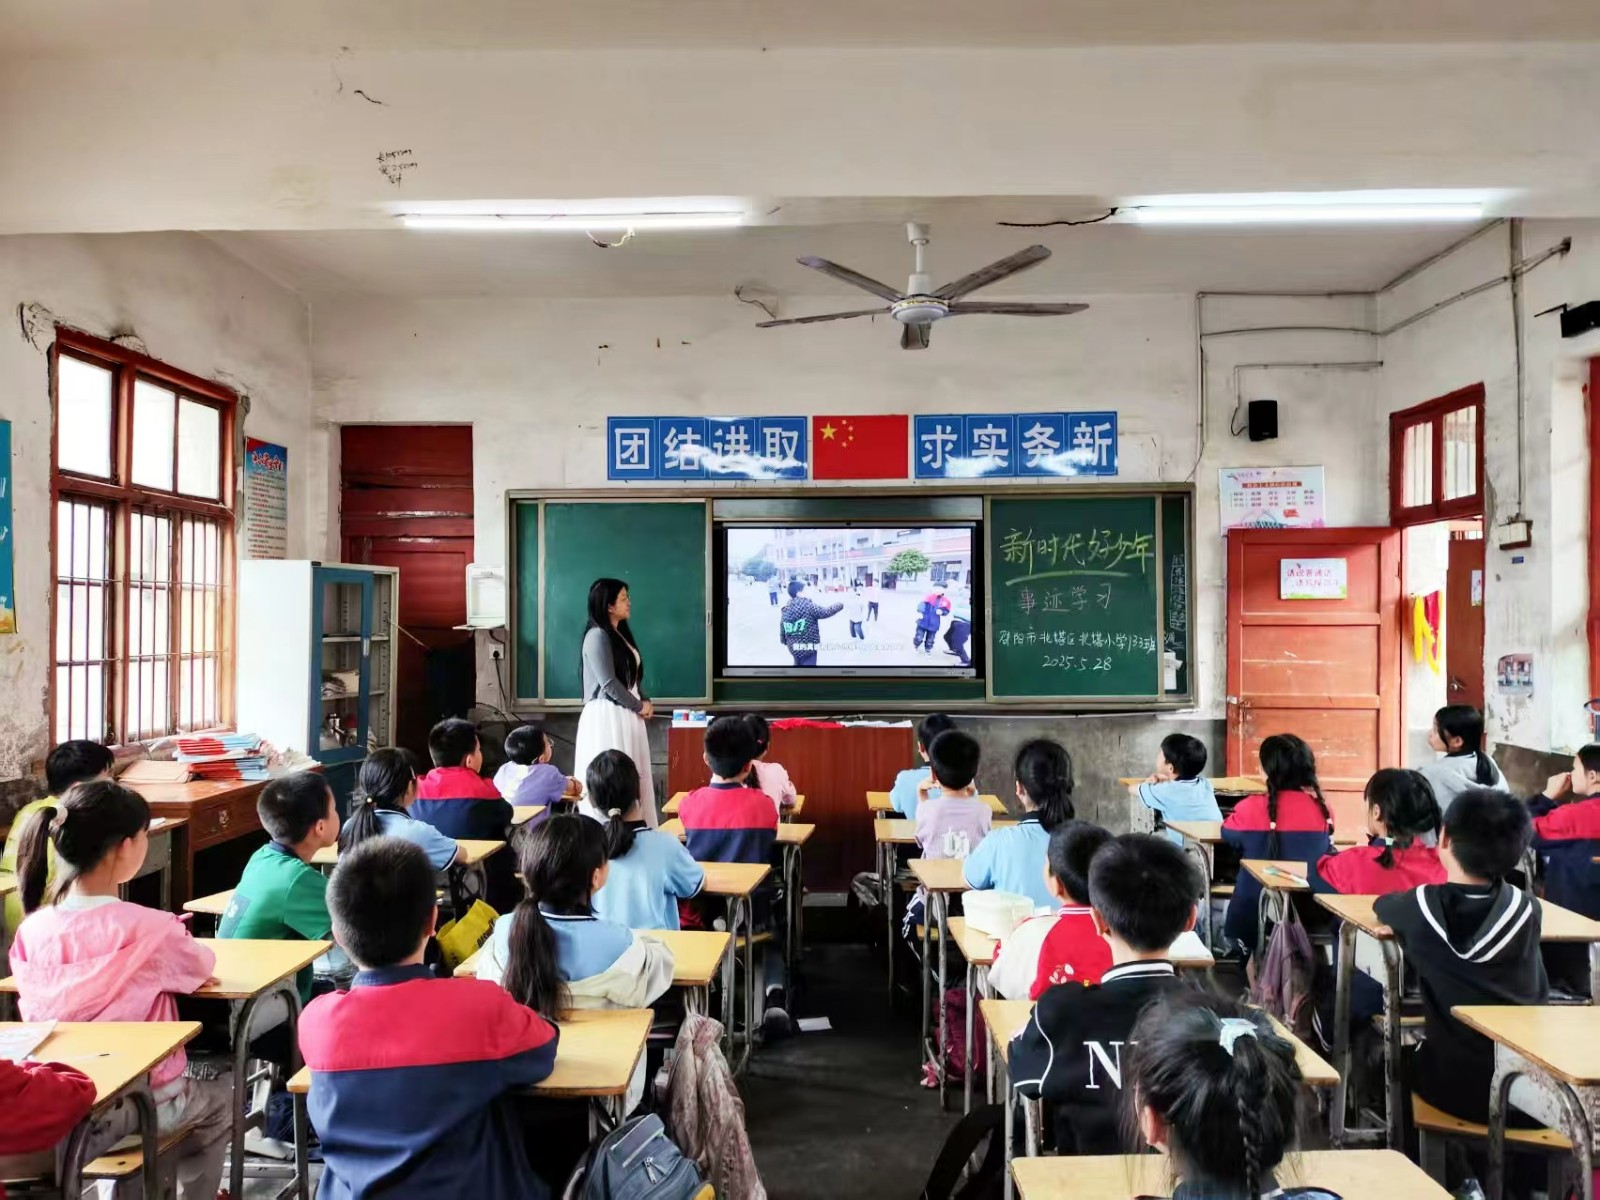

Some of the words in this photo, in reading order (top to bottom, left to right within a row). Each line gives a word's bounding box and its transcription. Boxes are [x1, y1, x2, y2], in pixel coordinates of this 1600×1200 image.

[614, 426, 801, 471] 团结进取
[920, 421, 1113, 470] 求实务新
[1000, 528, 1154, 575] 新时代好少年
[1017, 583, 1112, 615] 事迹学习
[1042, 654, 1113, 671] 2025.5.28
